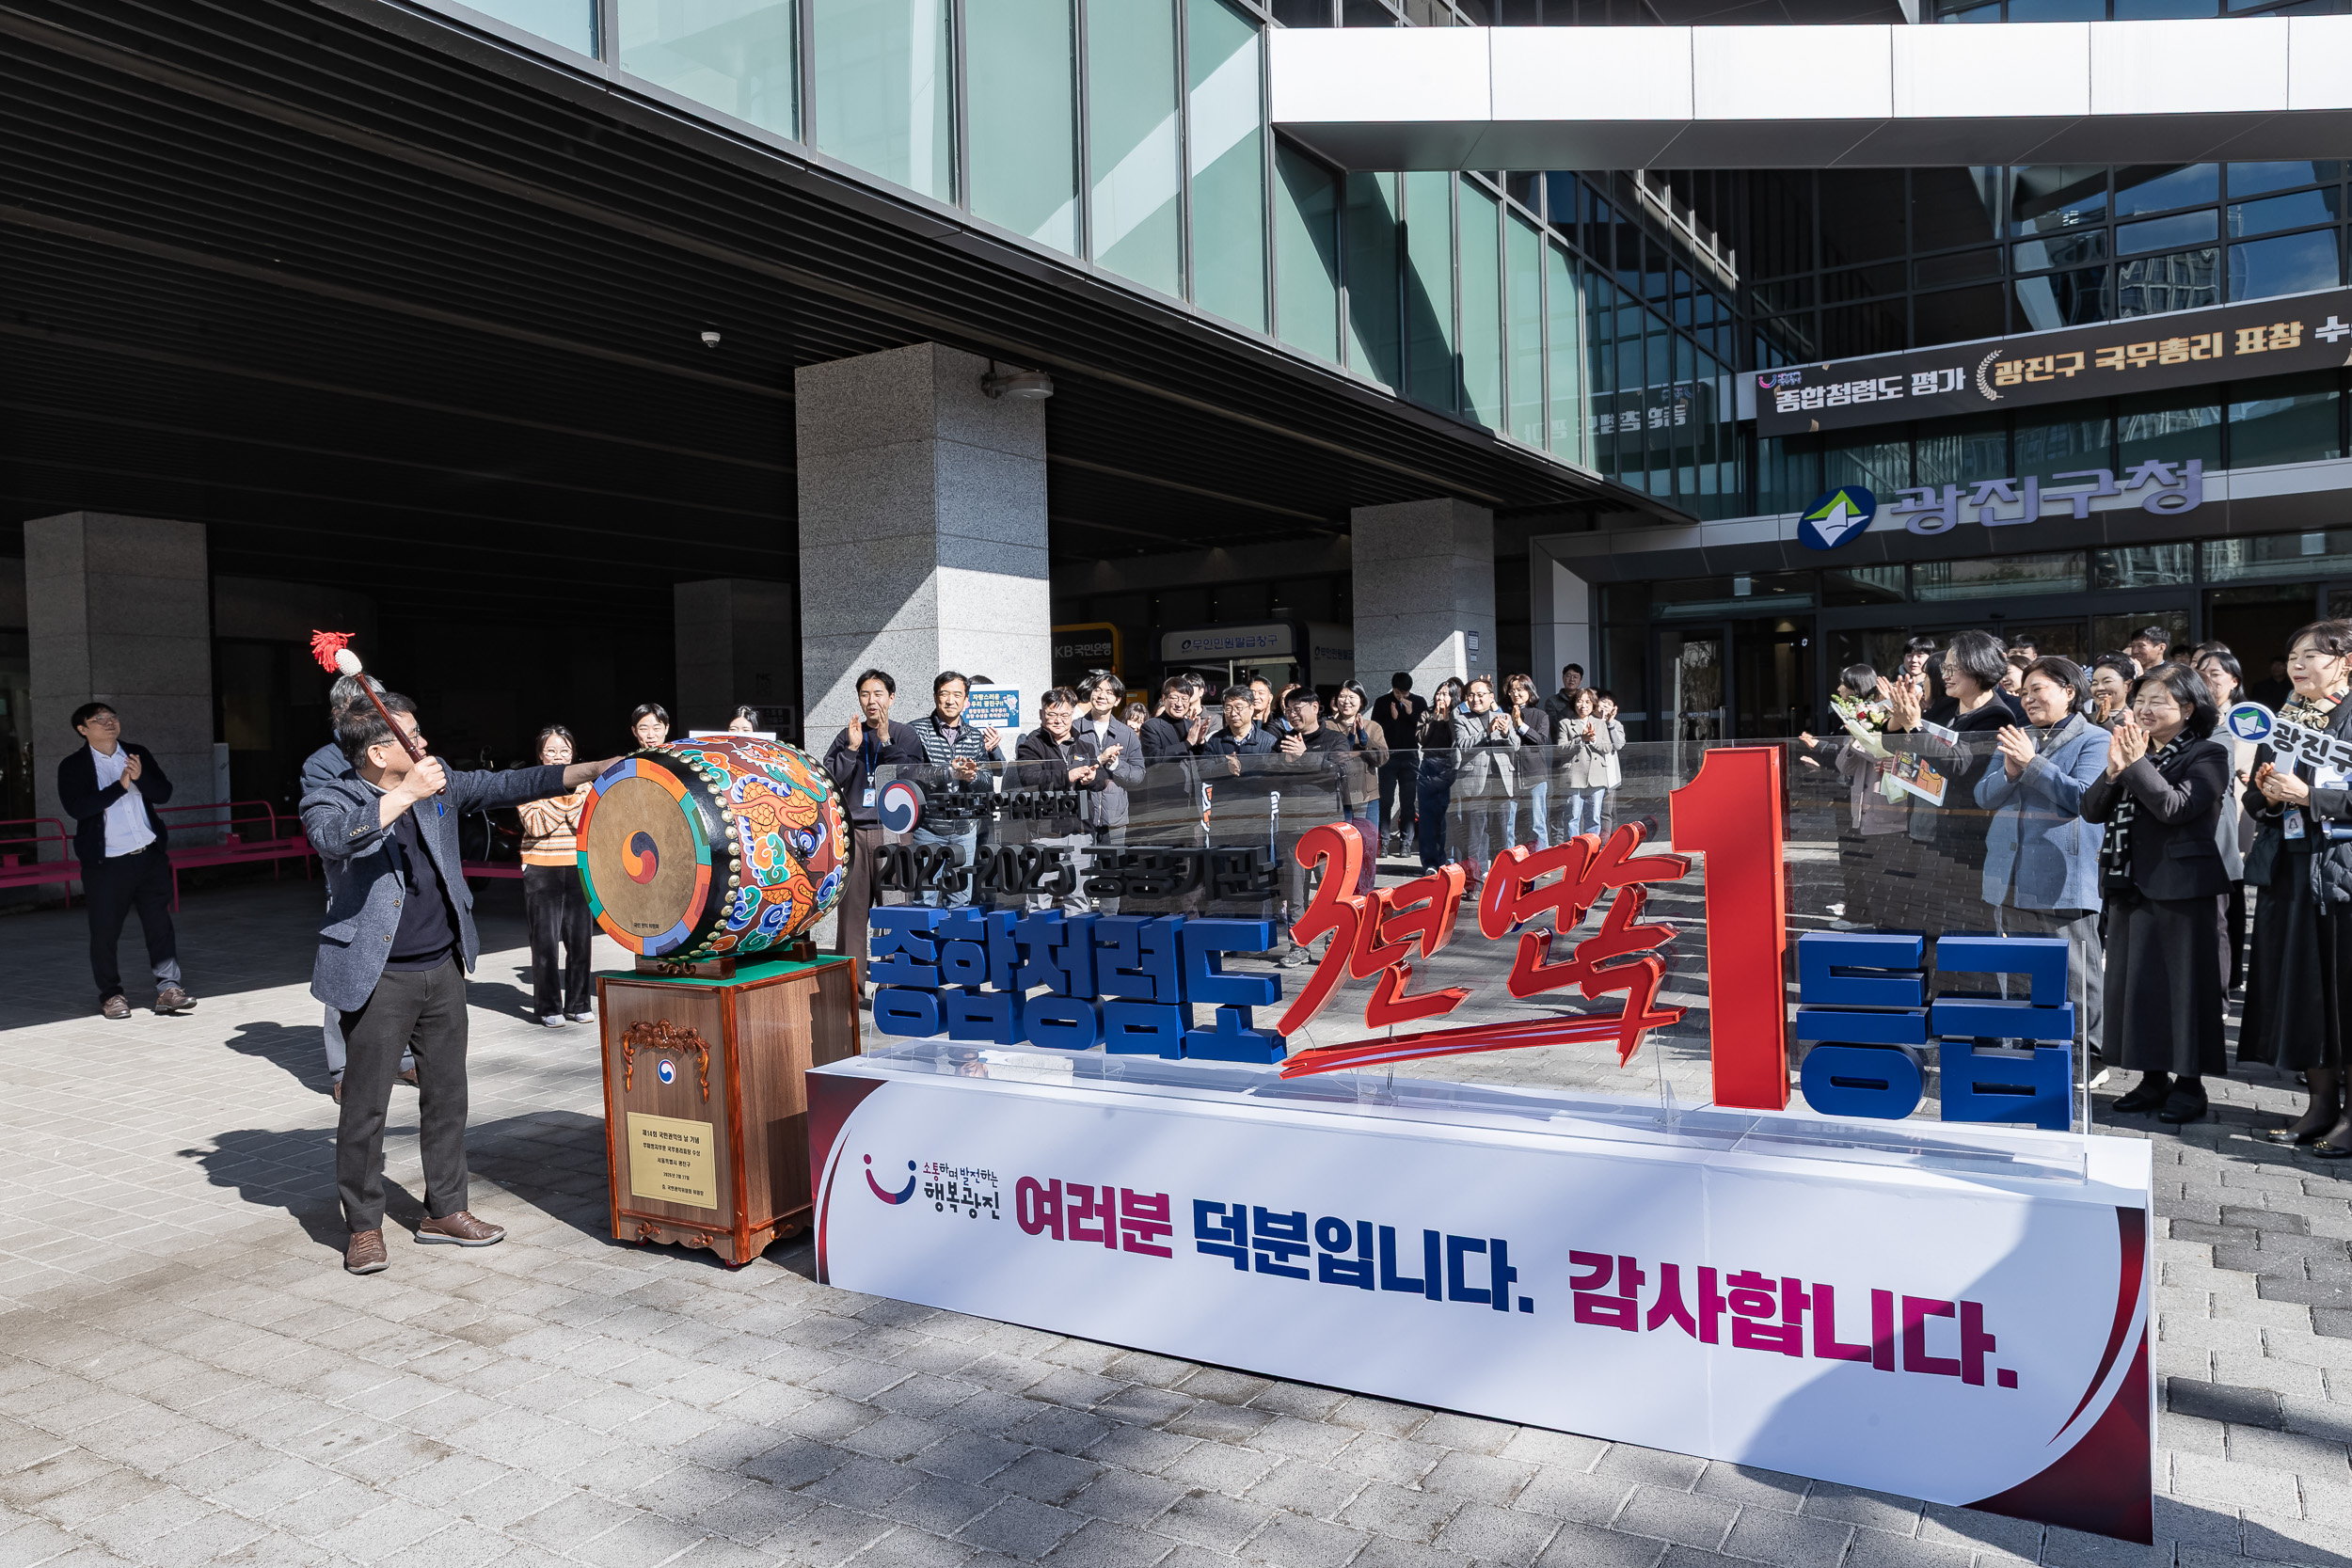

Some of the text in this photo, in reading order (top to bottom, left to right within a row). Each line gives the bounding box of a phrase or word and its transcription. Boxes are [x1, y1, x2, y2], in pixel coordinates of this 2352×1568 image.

[1775, 374, 1904, 414] 종합청렴도
[1911, 367, 1967, 397] 평가
[1994, 351, 2087, 388] 광진구
[2094, 333, 2224, 372] 국무총리
[2234, 321, 2305, 356] 표창
[2314, 315, 2352, 343] 수
[1890, 458, 2203, 536] 광진구청
[1193, 634, 1279, 651] 무인민원발급창구
[2273, 722, 2352, 773] 광진구
[875, 843, 1281, 902] 2023-2025 공공기관
[869, 905, 1288, 1064] 종합청렴도
[642, 1129, 658, 1138] 제14회
[659, 1132, 682, 1142] 국민권익의
[690, 1135, 700, 1145] 기념
[923, 1162, 999, 1189] 소통하며 발전하는
[924, 1180, 1001, 1221] 행복광진
[1016, 1174, 2019, 1390] 여러분 덕분입니다. 감사합니다.
